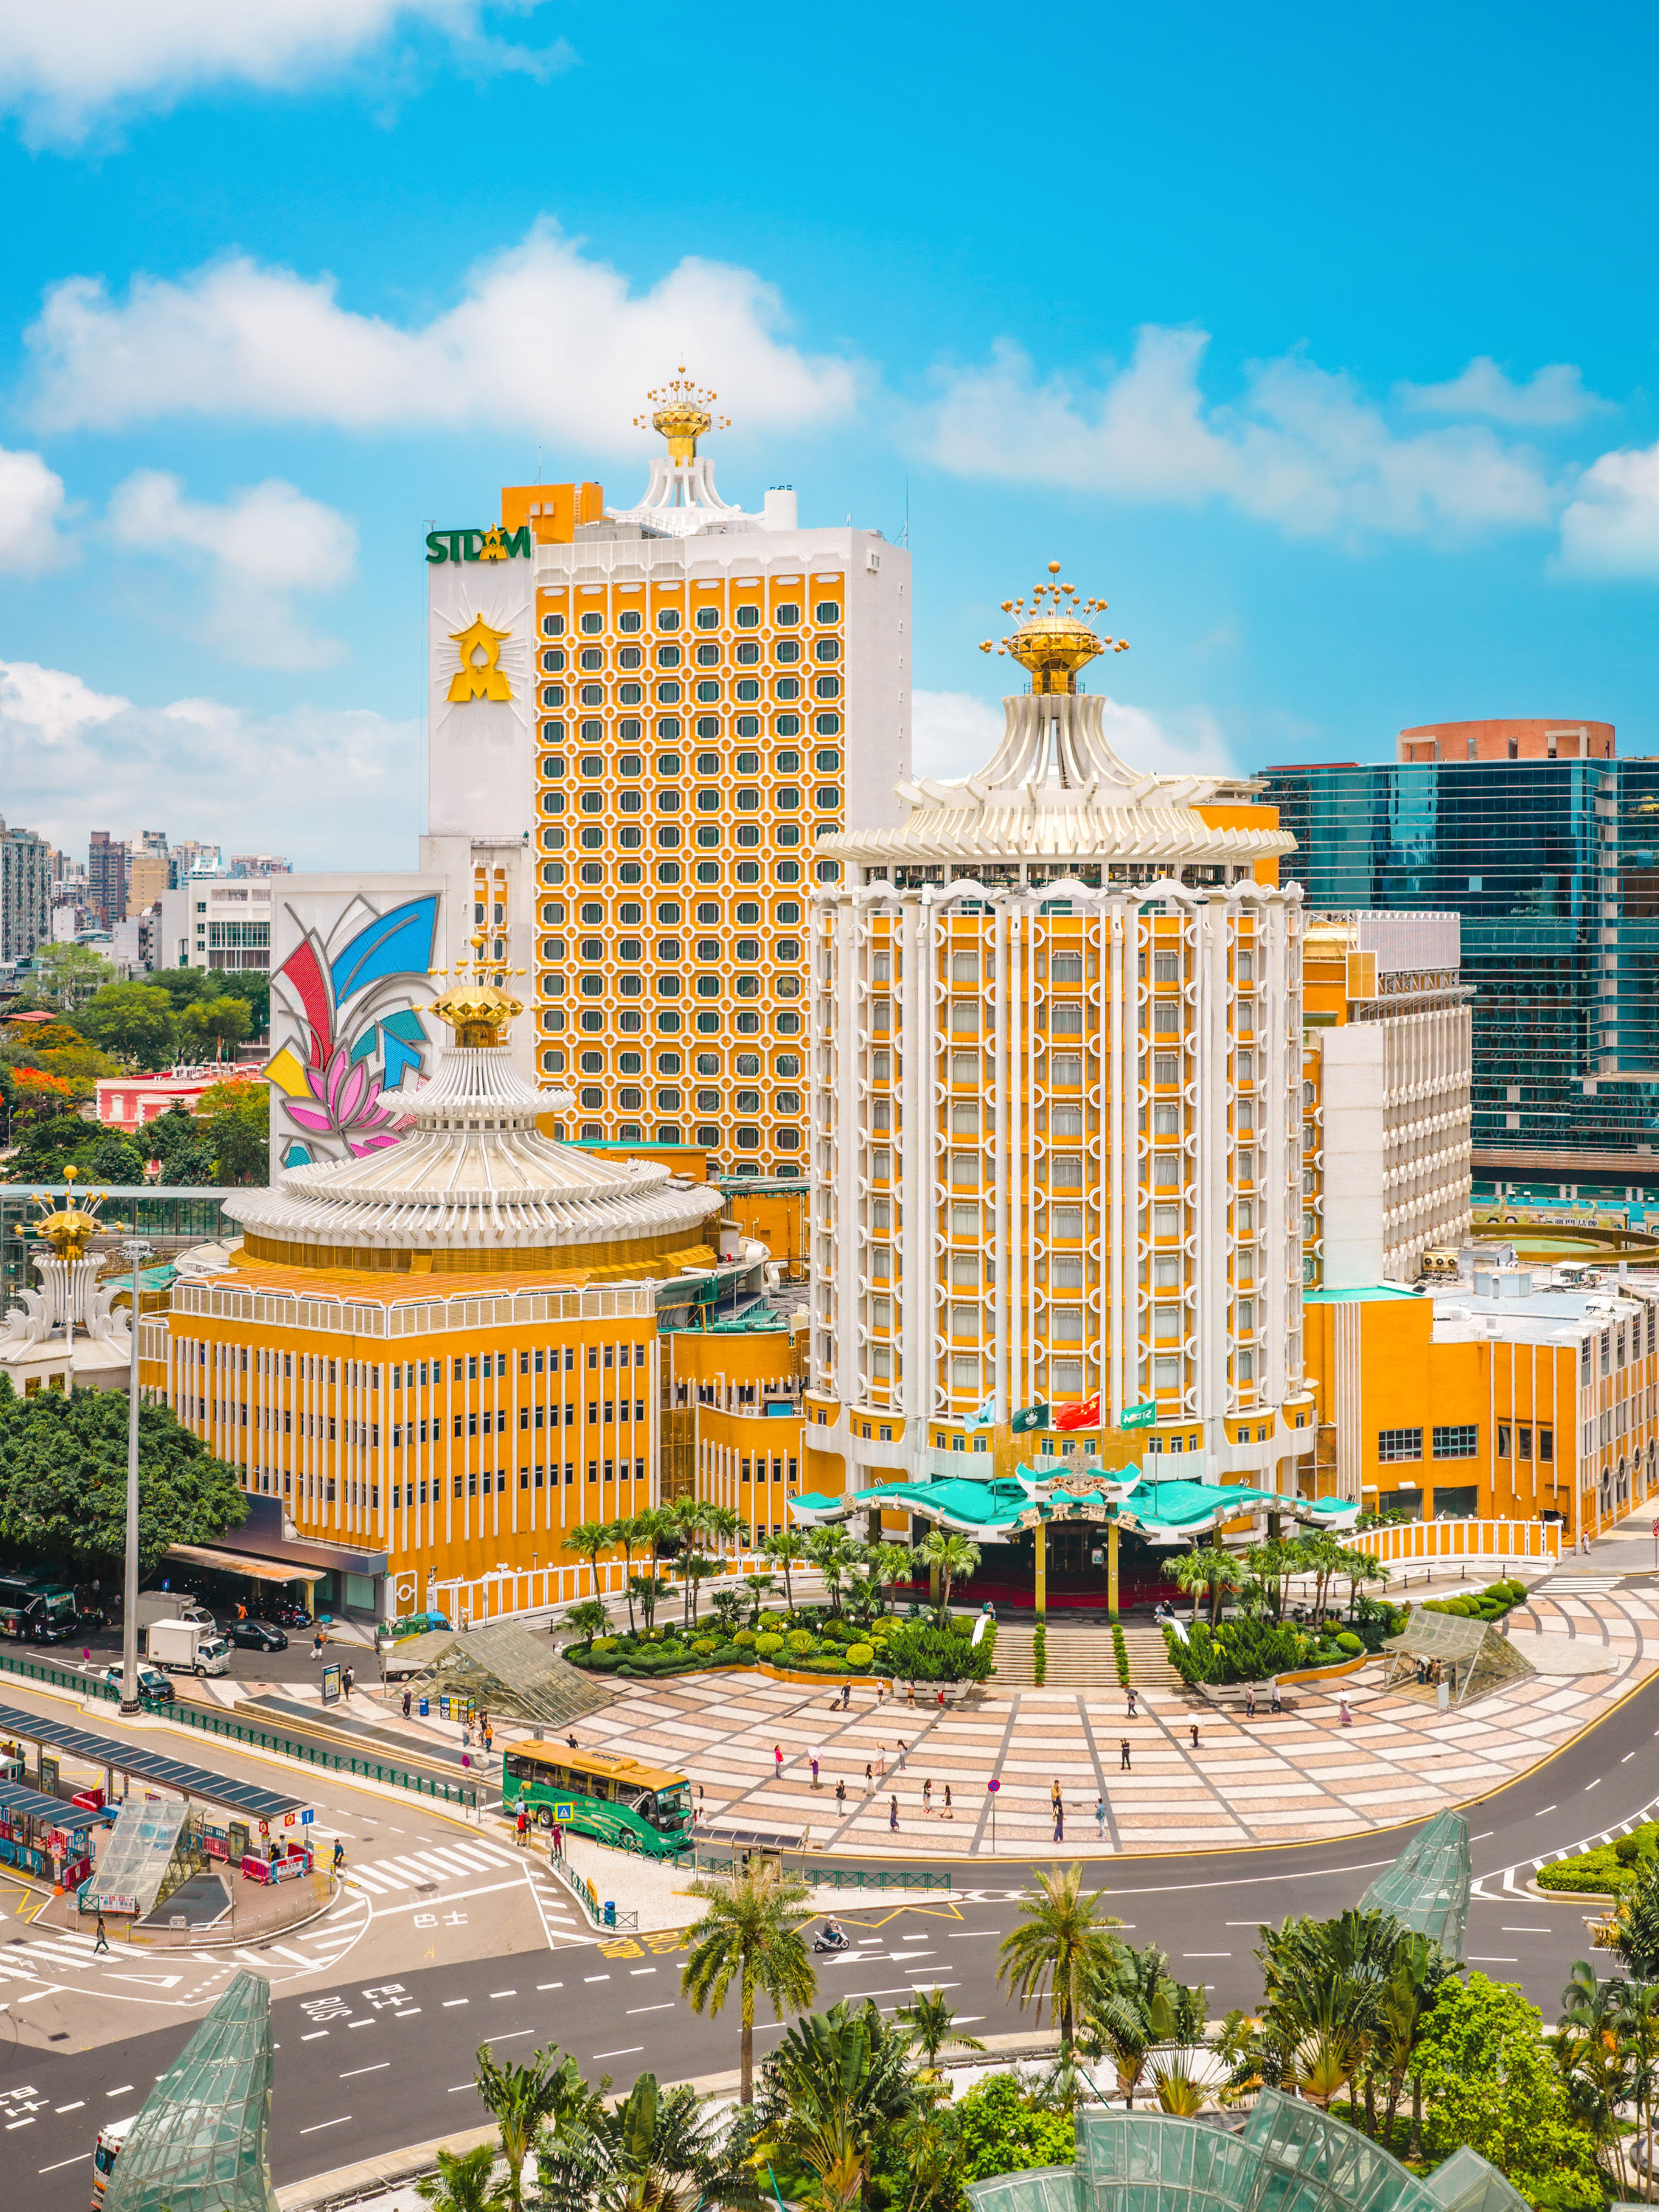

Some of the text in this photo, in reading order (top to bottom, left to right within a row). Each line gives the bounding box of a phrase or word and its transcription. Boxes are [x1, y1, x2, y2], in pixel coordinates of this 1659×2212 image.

[413, 1910, 468, 1928] 巴士
[641, 1931, 689, 1954] BUS
[299, 1995, 353, 2022] BUS
